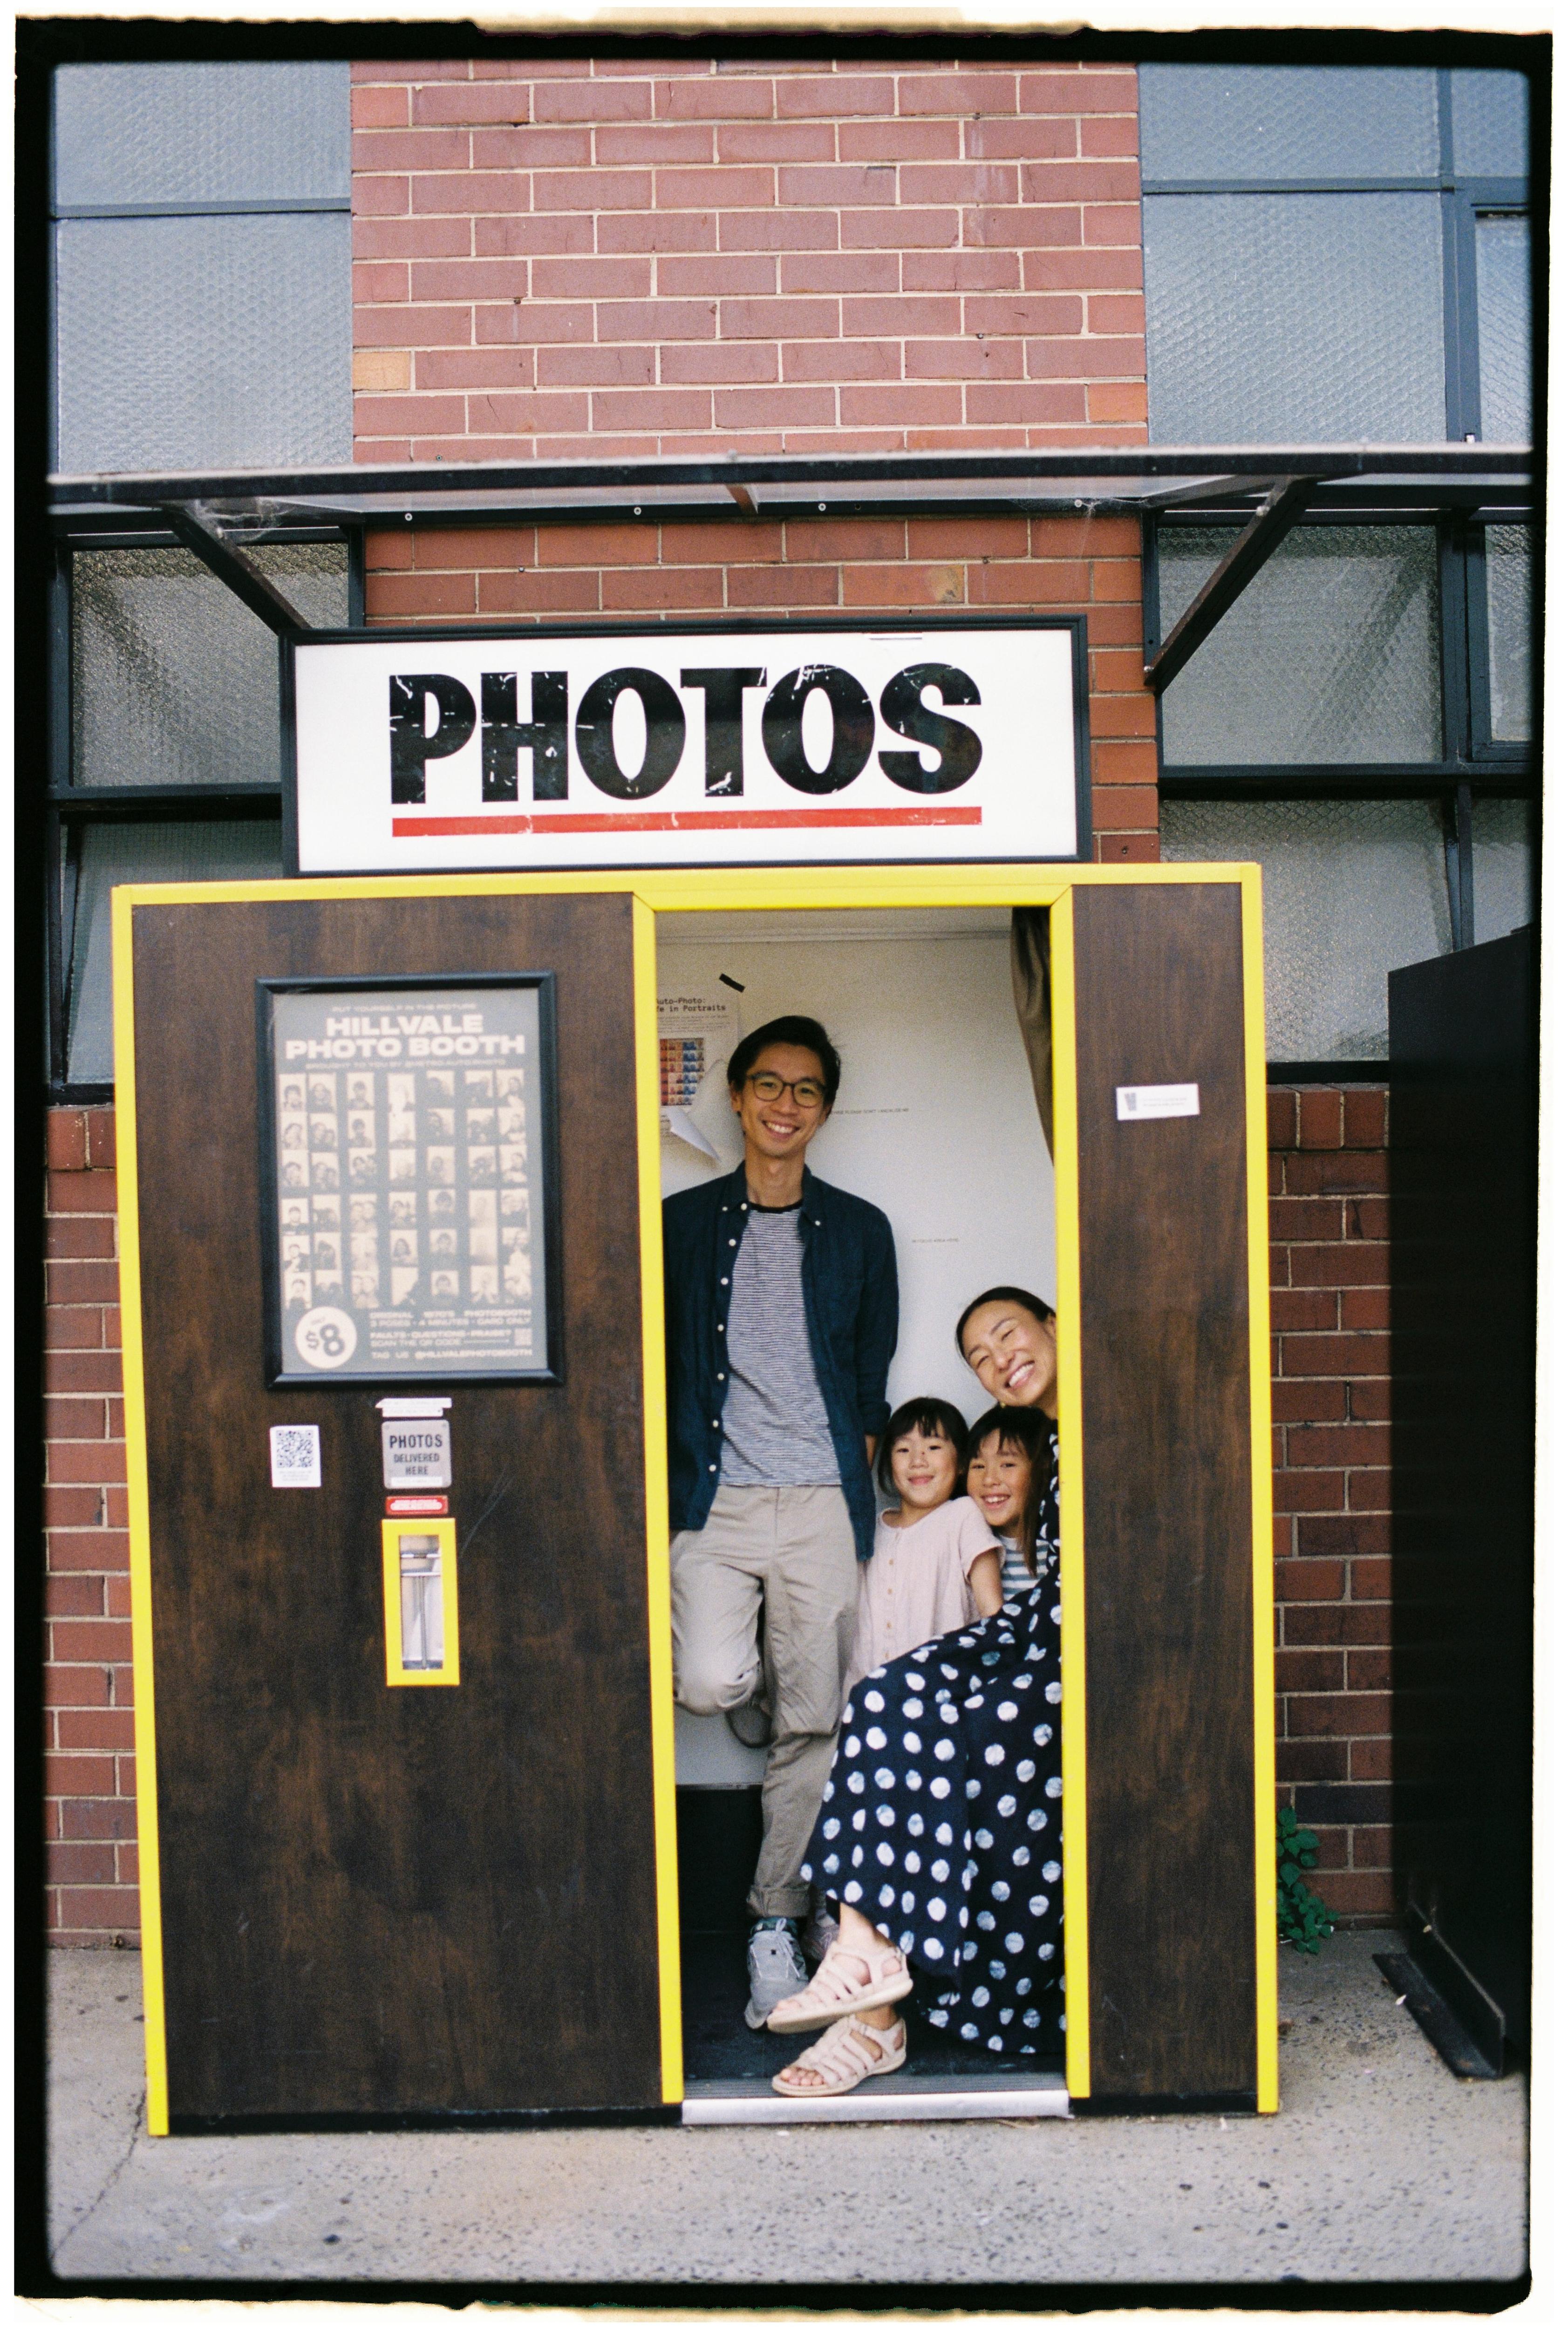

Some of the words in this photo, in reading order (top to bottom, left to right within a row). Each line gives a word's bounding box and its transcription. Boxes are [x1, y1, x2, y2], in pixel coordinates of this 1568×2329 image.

[389, 663, 983, 804] PHOTOS
[326, 1014, 483, 1037] HILLVALE
[285, 1036, 402, 1060] PHOTO
[408, 1034, 525, 1057] BOOTH
[305, 1323, 346, 1357] $8
[389, 1433, 443, 1449] PHOTOS
[393, 1452, 440, 1464] DELIVERED
[405, 1465, 429, 1476] HERE
